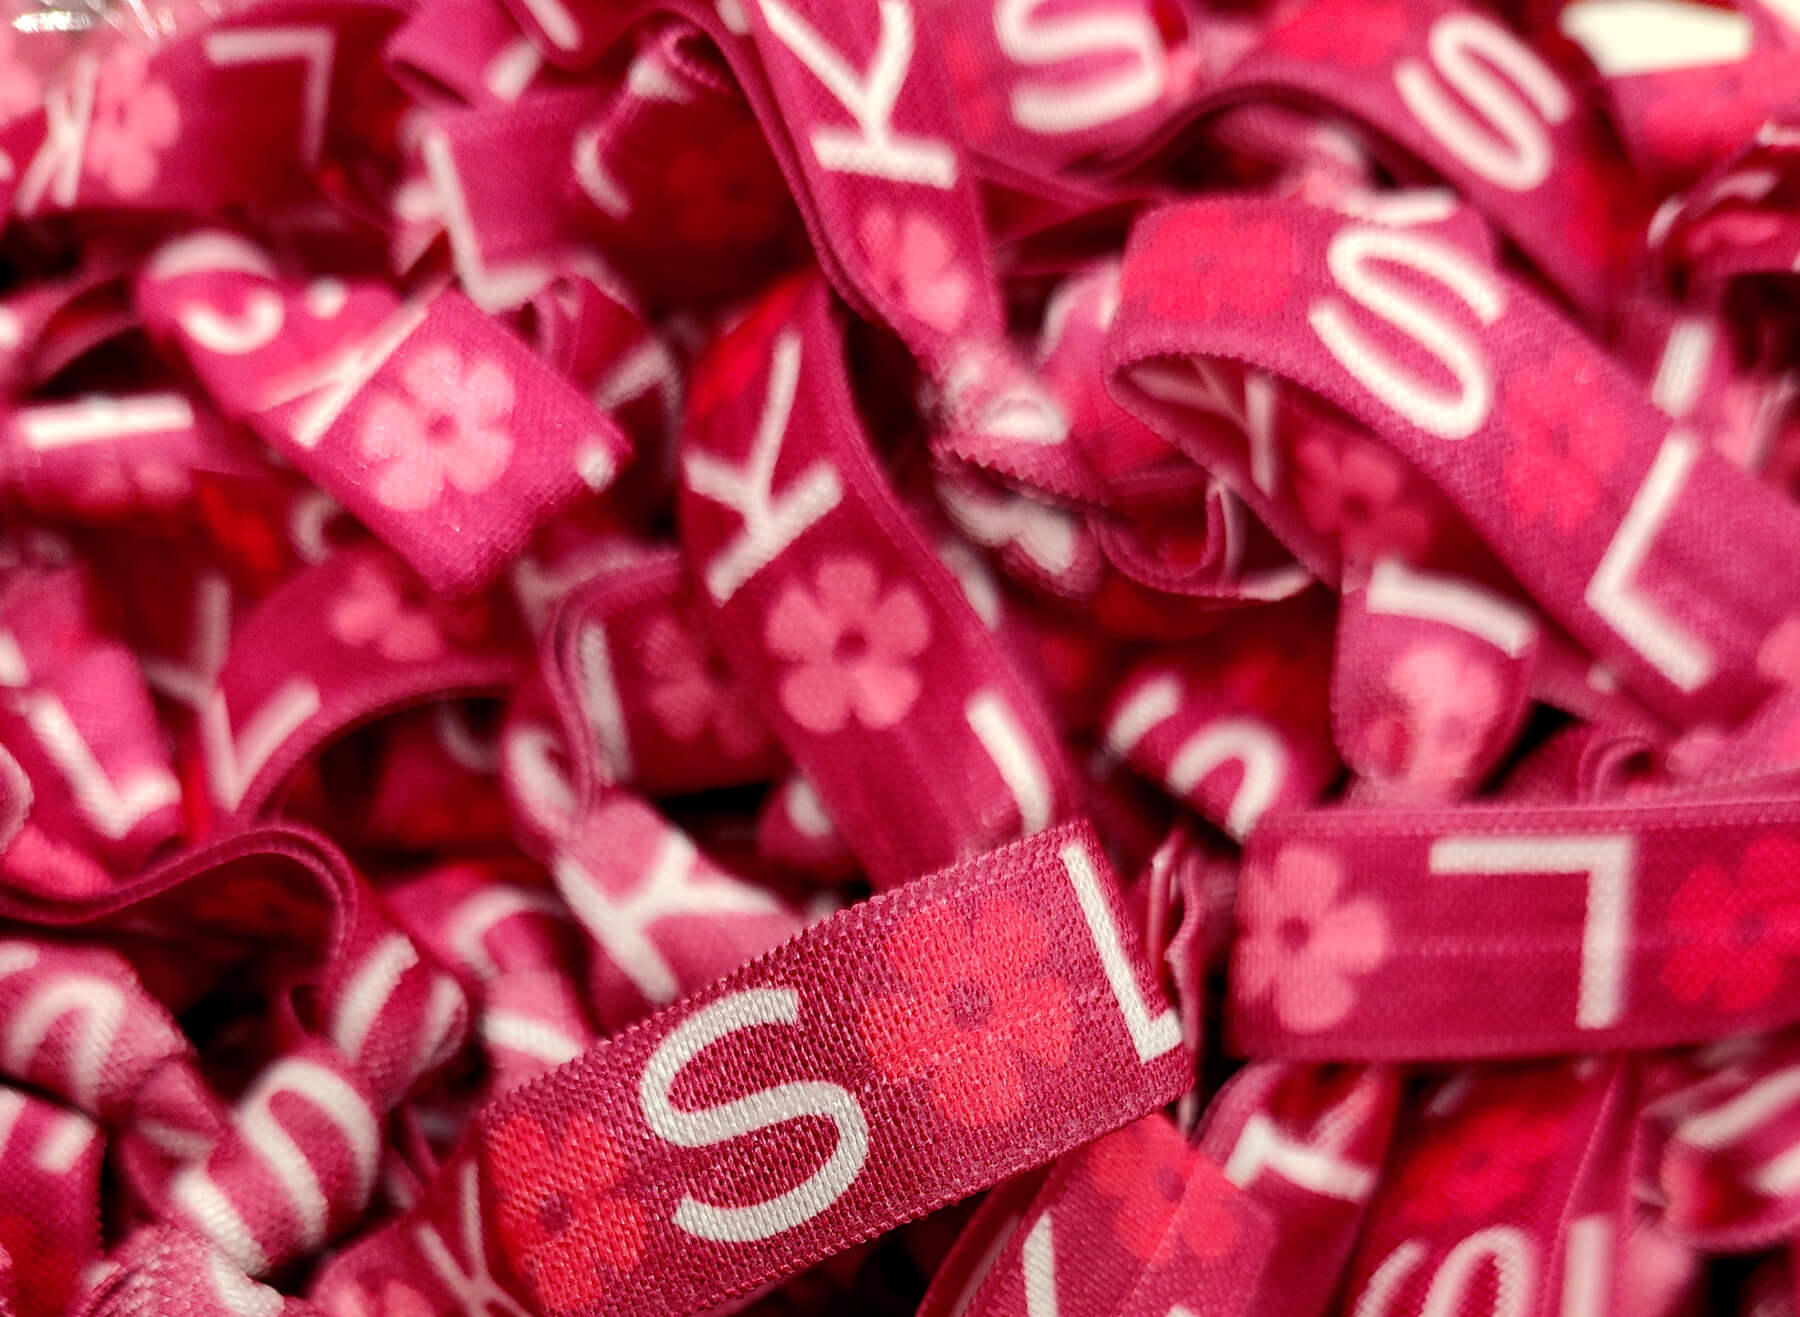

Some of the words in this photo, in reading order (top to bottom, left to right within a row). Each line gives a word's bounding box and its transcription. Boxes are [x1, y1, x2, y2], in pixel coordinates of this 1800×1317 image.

[755, 0, 957, 190] K
[1394, 13, 1572, 192] S
[683, 330, 844, 608] K
[1309, 228, 1504, 440] S
[1585, 428, 1712, 694] L
[640, 987, 869, 1243] S
[1059, 838, 1184, 1066] L
[1430, 834, 1634, 1030] L
